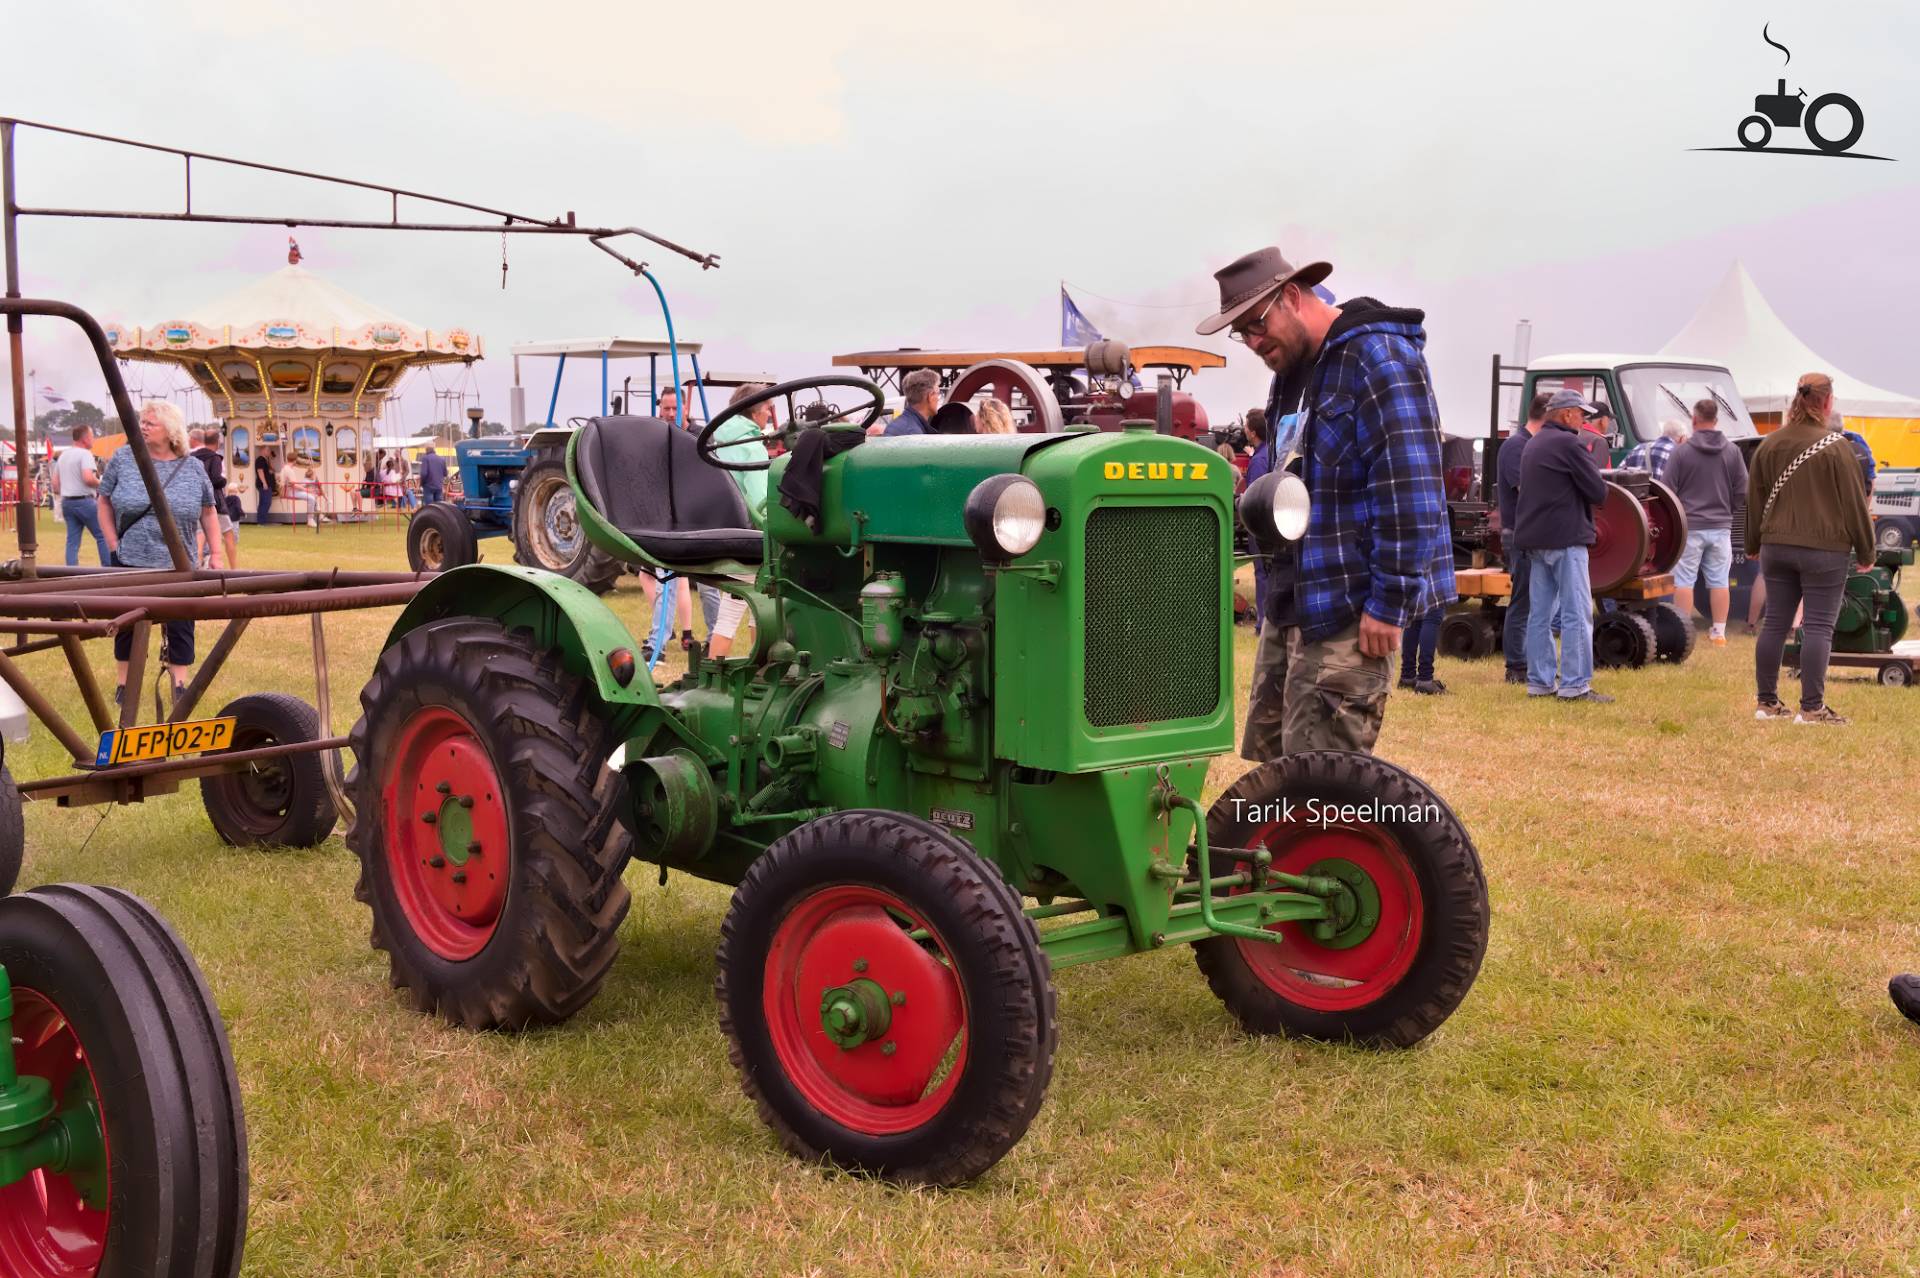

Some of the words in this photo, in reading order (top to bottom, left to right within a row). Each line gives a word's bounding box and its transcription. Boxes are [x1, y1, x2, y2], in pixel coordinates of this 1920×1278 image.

[1103, 462, 1208, 480] DEUTZ
[99, 751, 108, 760] NL
[932, 811, 971, 825] DEUTZ
